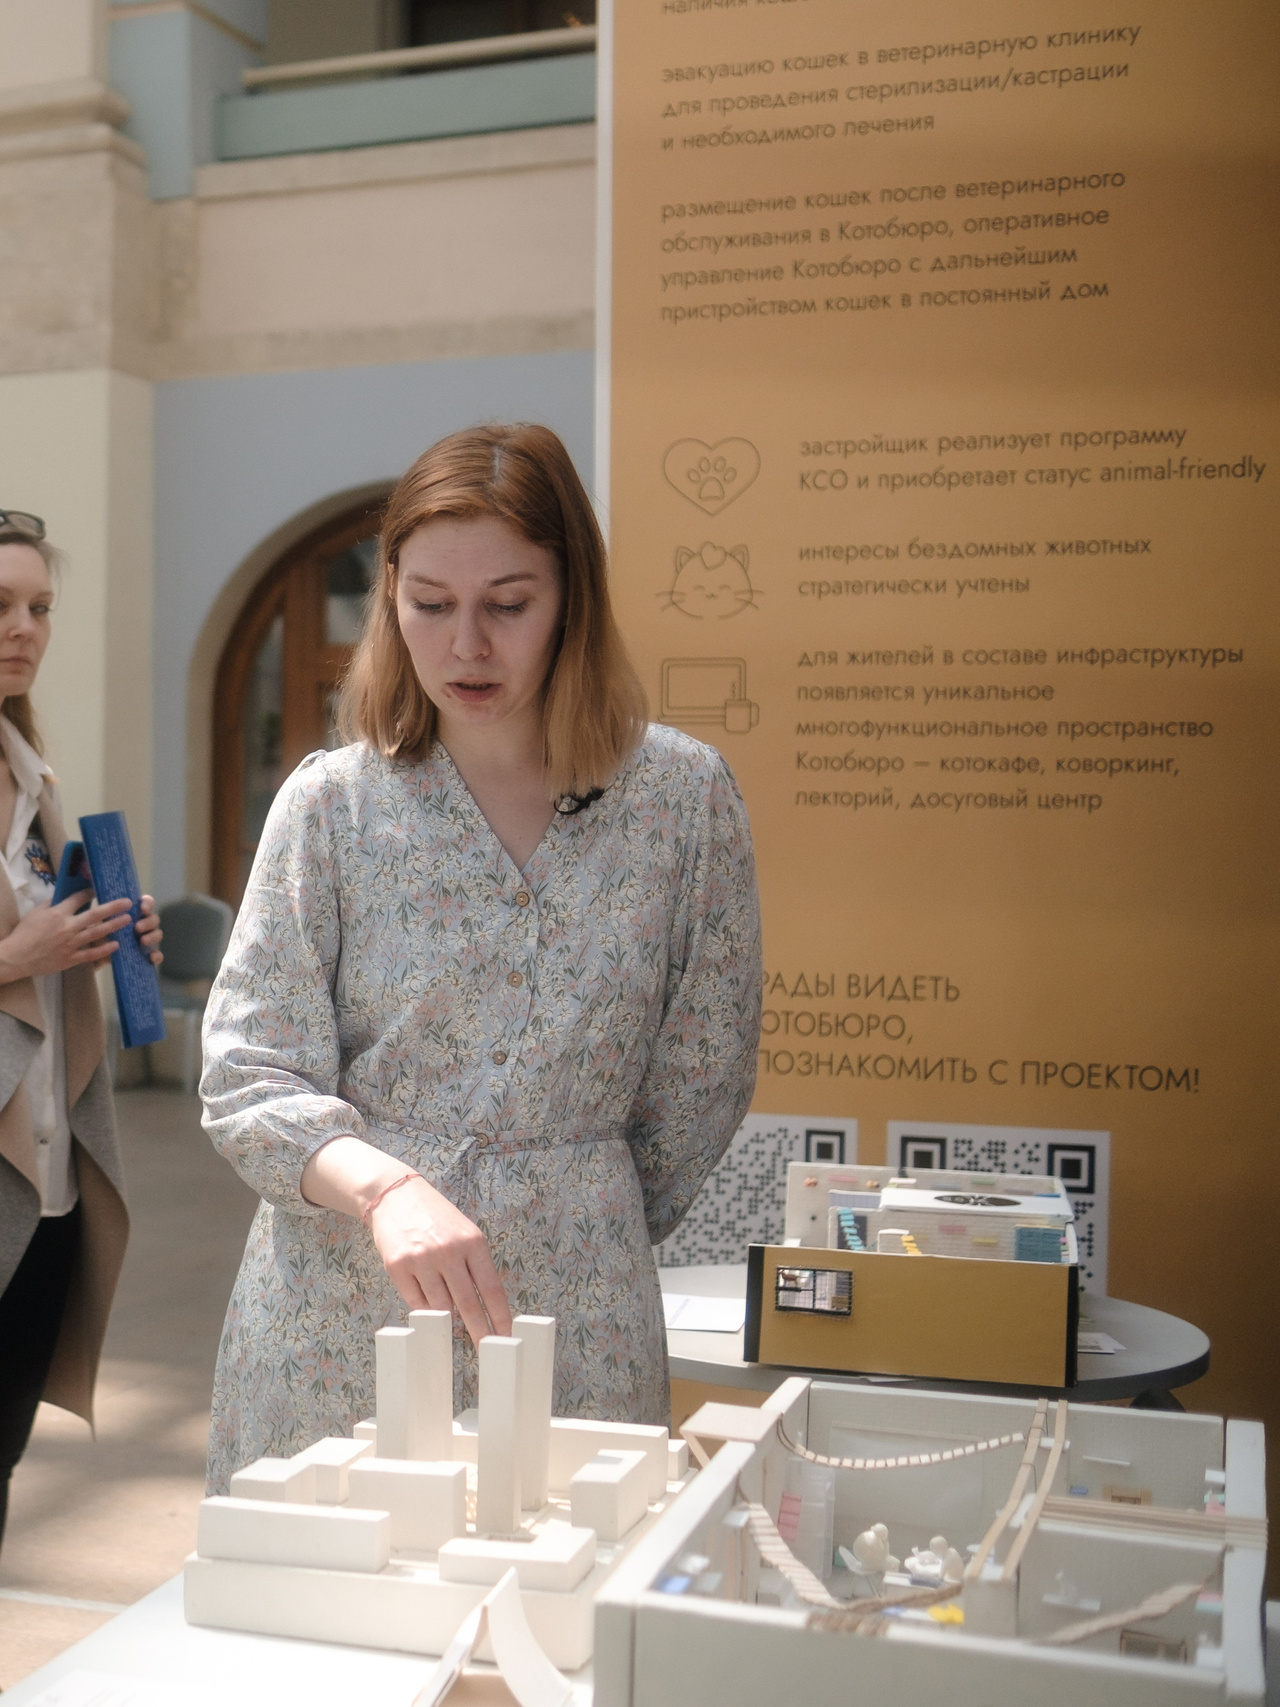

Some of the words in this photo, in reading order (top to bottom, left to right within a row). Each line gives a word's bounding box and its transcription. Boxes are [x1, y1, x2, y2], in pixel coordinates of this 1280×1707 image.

[662, 58, 775, 84] эвакуацию
[781, 53, 849, 72] кошек
[857, 50, 869, 66] в
[876, 34, 1039, 65] ветеринарную
[1046, 25, 1142, 48] клинику
[660, 100, 702, 120] для
[709, 87, 839, 116] проведения
[846, 62, 1130, 103] стерилизации/кастрации
[660, 136, 675, 152] и
[680, 123, 837, 150] необходимого
[842, 114, 935, 137] лечения
[660, 195, 797, 224] размещение
[803, 190, 872, 209] кошек
[879, 184, 947, 204] после
[954, 171, 1127, 200] ветеринарного
[661, 228, 812, 256] обслуживания
[819, 227, 831, 243] в
[837, 216, 954, 242] Котобюро,
[962, 209, 1111, 236] оперативное
[659, 265, 785, 293] управление
[791, 254, 902, 279] Котобюро
[908, 256, 921, 273] с
[929, 246, 1078, 273] дальнейшим
[659, 297, 818, 326] пристройством
[823, 294, 892, 312] кошек
[900, 292, 913, 309] в
[919, 280, 1052, 307] постоянный
[1059, 282, 1110, 302] дом
[800, 433, 929, 460] застройщик
[937, 432, 1052, 457] реализует
[1059, 428, 1188, 452] программу
[798, 468, 849, 492] КСО
[856, 475, 870, 490] и
[877, 465, 1017, 494] приобретает
[1024, 467, 1091, 489] статус
[1099, 454, 1267, 484] animal-friendly
[797, 543, 900, 565] интересы
[906, 536, 1037, 560] бездомных
[1045, 538, 1152, 556] животных
[797, 578, 948, 601] стратегически
[955, 577, 1031, 599] учтены
[796, 650, 839, 669] для
[846, 645, 935, 666] жителей
[942, 649, 955, 666] в
[961, 648, 1048, 666] составе
[1056, 646, 1244, 670] инфраструктуры
[796, 685, 915, 702] появляется
[922, 684, 1056, 706] уникальное
[794, 719, 1049, 741] многофункциональное
[1056, 720, 1215, 742] пространство
[795, 749, 905, 777] Котобюро
[940, 755, 1046, 777] котокафе,
[1055, 757, 1180, 778] коворкинг,
[795, 787, 901, 812] лекторий,
[909, 788, 1029, 813] досуговый
[1036, 793, 1103, 814] центр
[846, 972, 961, 1003] ВИДЕТЬ
[761, 1009, 913, 1045] ОТОБЮРО,
[987, 1058, 1009, 1087] С
[1020, 1059, 1200, 1094] ПРОЕКТОМ!
